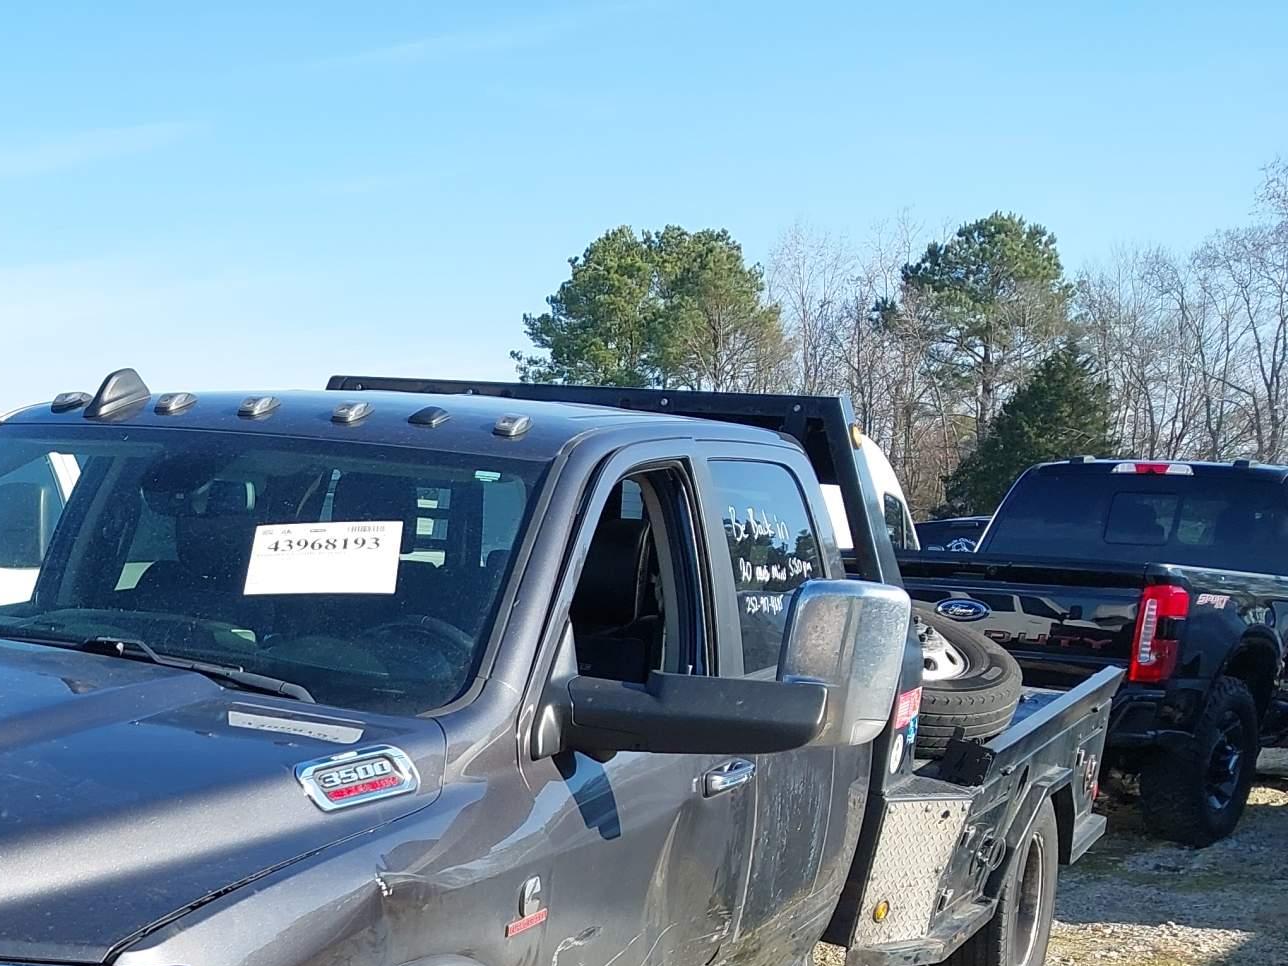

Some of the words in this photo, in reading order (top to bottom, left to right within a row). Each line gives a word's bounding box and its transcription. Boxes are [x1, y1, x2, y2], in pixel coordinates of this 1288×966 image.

[747, 508, 775, 540] Back
[774, 515, 789, 540] in
[267, 537, 380, 552] 43968193
[948, 603, 976, 616] Ford
[983, 629, 1113, 650] DUTY
[321, 761, 392, 788] 3500
